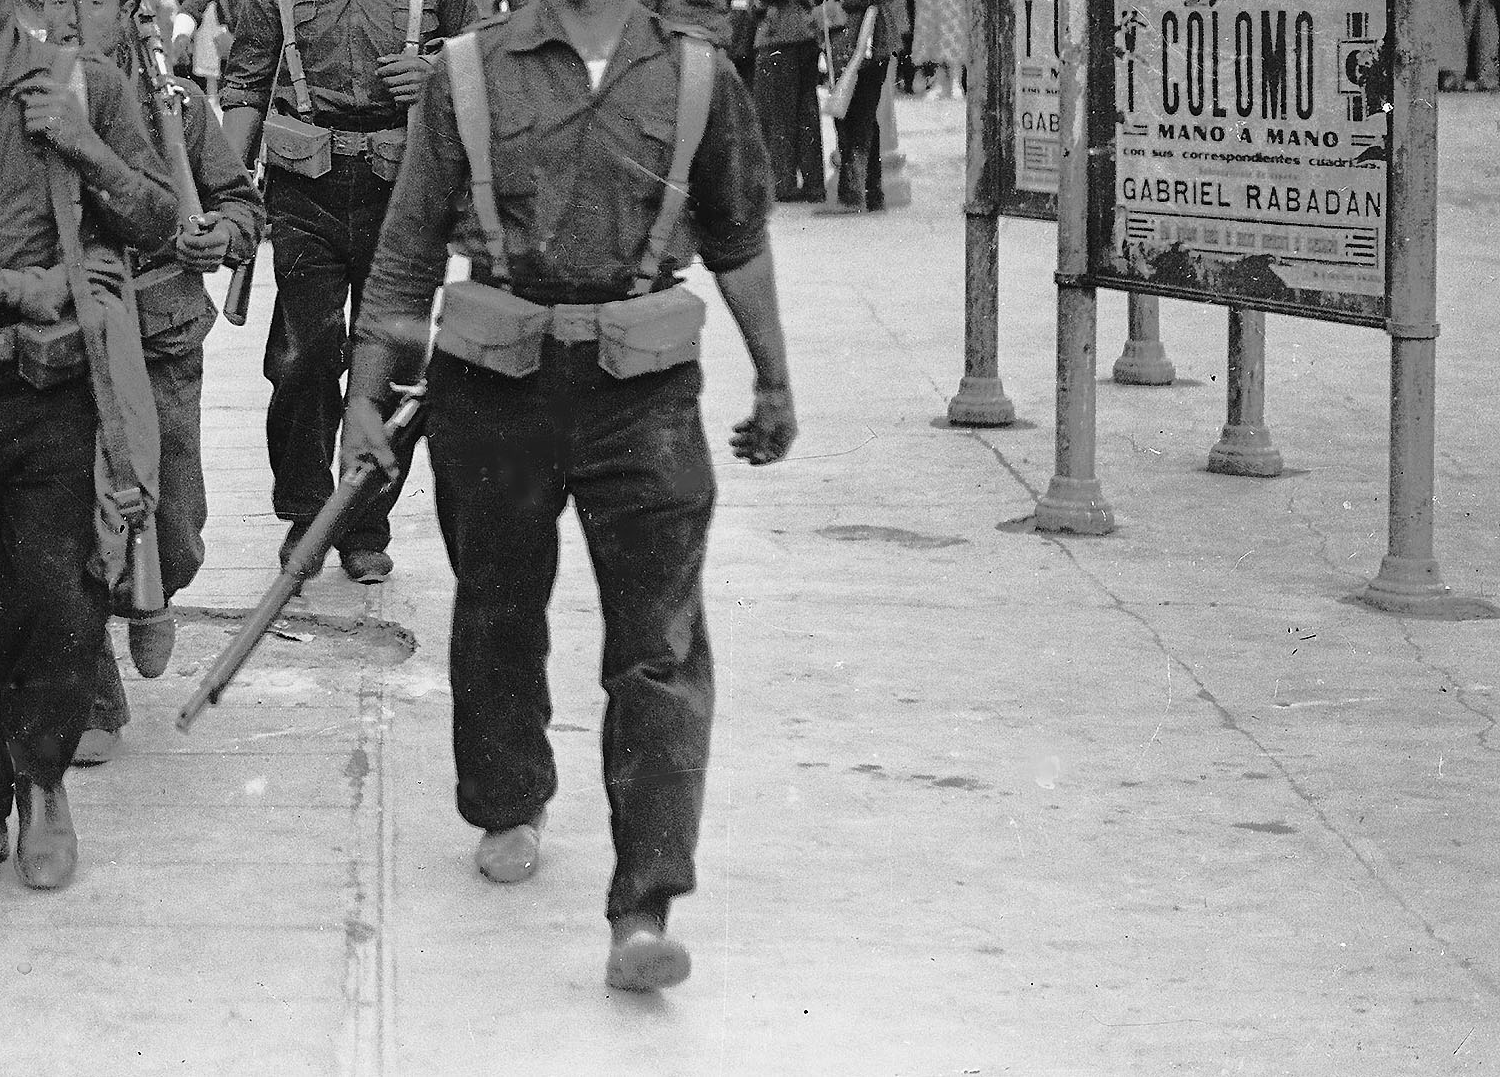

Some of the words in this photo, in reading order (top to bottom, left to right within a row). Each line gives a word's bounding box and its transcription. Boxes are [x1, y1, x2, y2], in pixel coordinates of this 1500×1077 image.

[1161, 10, 1314, 120] COLOMO
[1158, 123, 1226, 142] MANO
[1239, 127, 1253, 143] A
[1266, 128, 1339, 148] MANO
[1123, 148, 1145, 157] con
[1152, 150, 1174, 159] sus
[1182, 151, 1301, 166] correspondientes
[1122, 177, 1231, 208] GABRIEL
[1246, 185, 1382, 218] RABADAN
